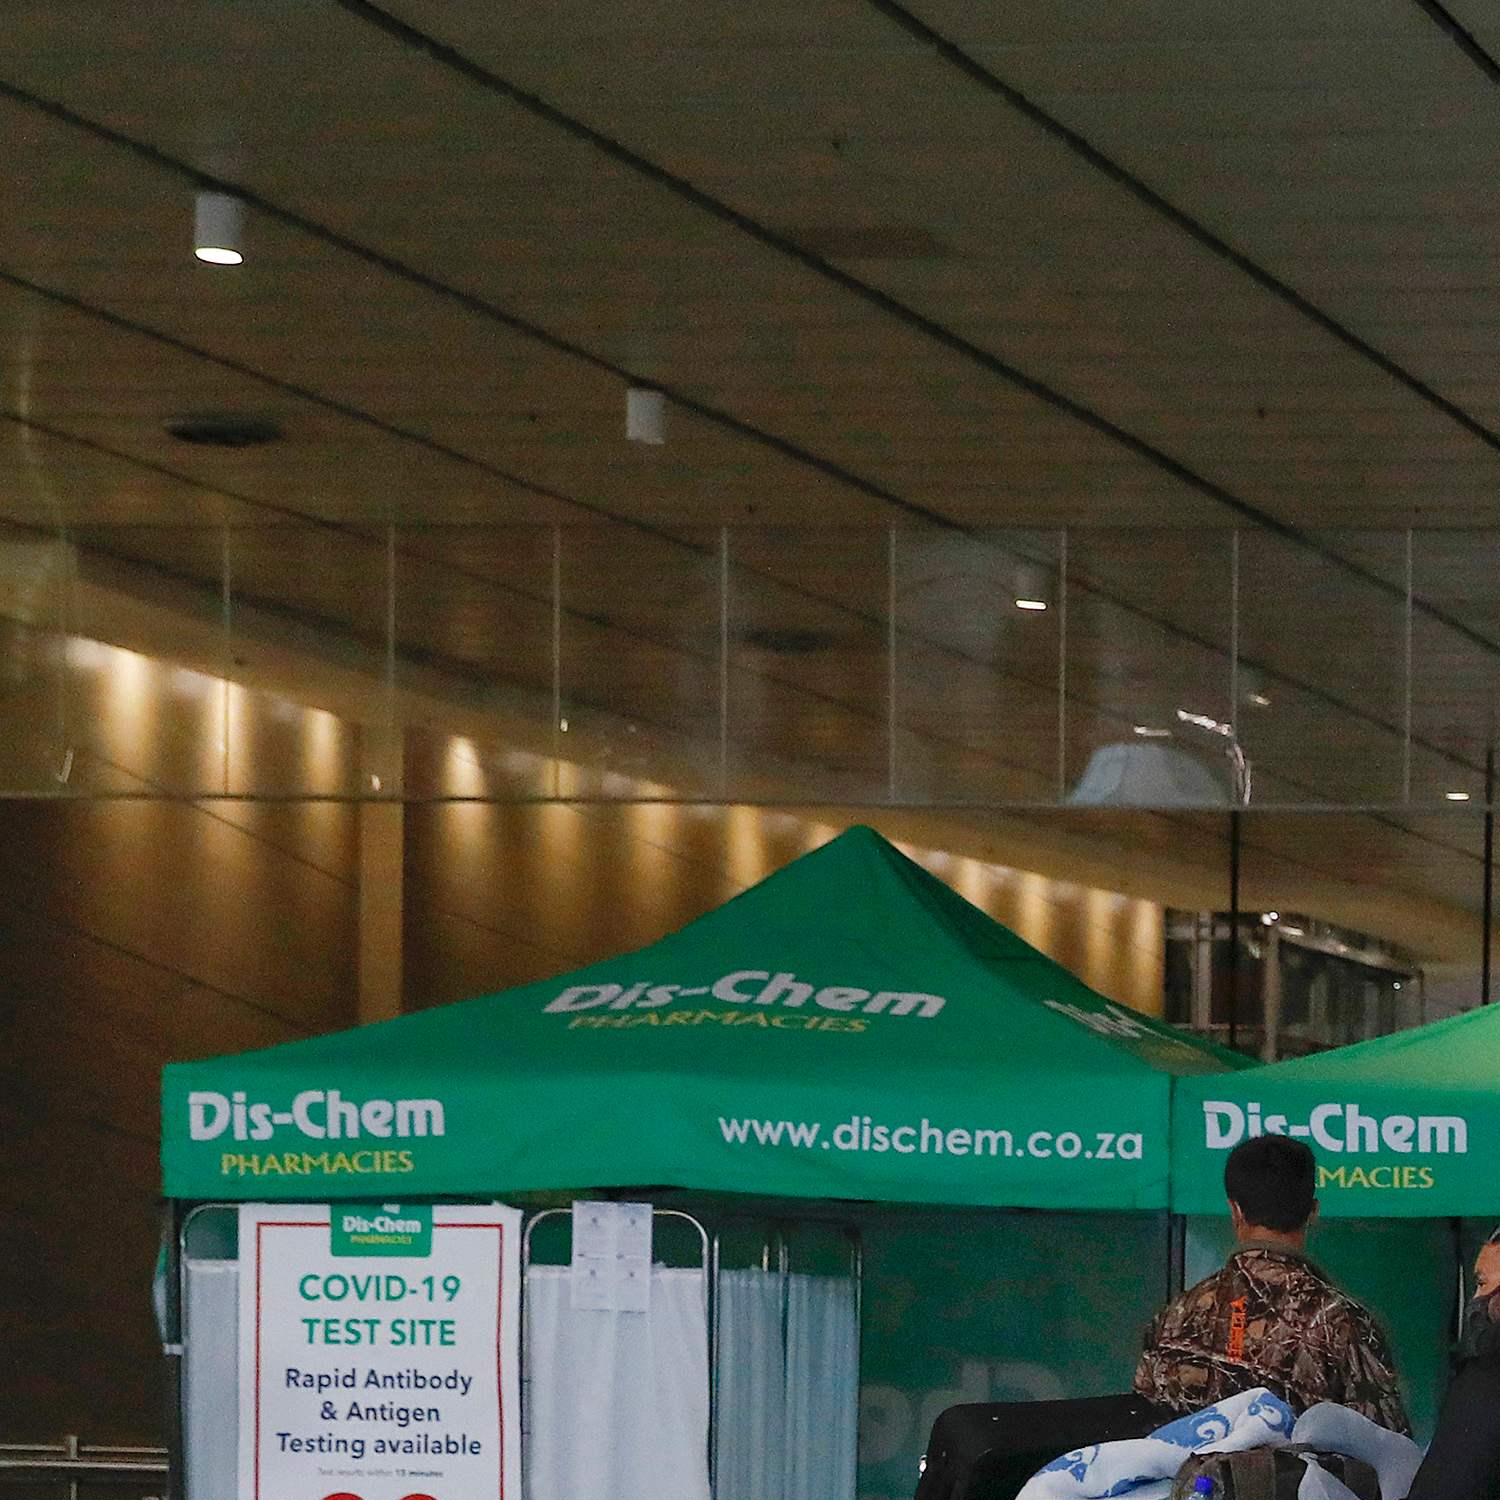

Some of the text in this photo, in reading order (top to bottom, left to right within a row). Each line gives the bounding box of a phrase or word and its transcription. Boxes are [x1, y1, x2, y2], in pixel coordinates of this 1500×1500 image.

[543, 970, 946, 1020] Dis-Chem
[568, 1009, 870, 1032] PHARMACIES
[188, 1090, 446, 1141] Dis-Chem
[1203, 1101, 1467, 1153] Dis-Chem
[719, 1116, 1143, 1160] www.dischem.co.za
[221, 1150, 414, 1176] PHARMACIES
[1315, 1165, 1435, 1189] MACIES
[342, 1215, 422, 1233] Dis-Chem
[299, 1274, 462, 1302] COVID-19
[301, 1318, 456, 1346] TEST SITE
[285, 1368, 473, 1396] Rapid Antibody
[320, 1400, 441, 1427] & Antigen
[276, 1432, 482, 1459] Testing available
